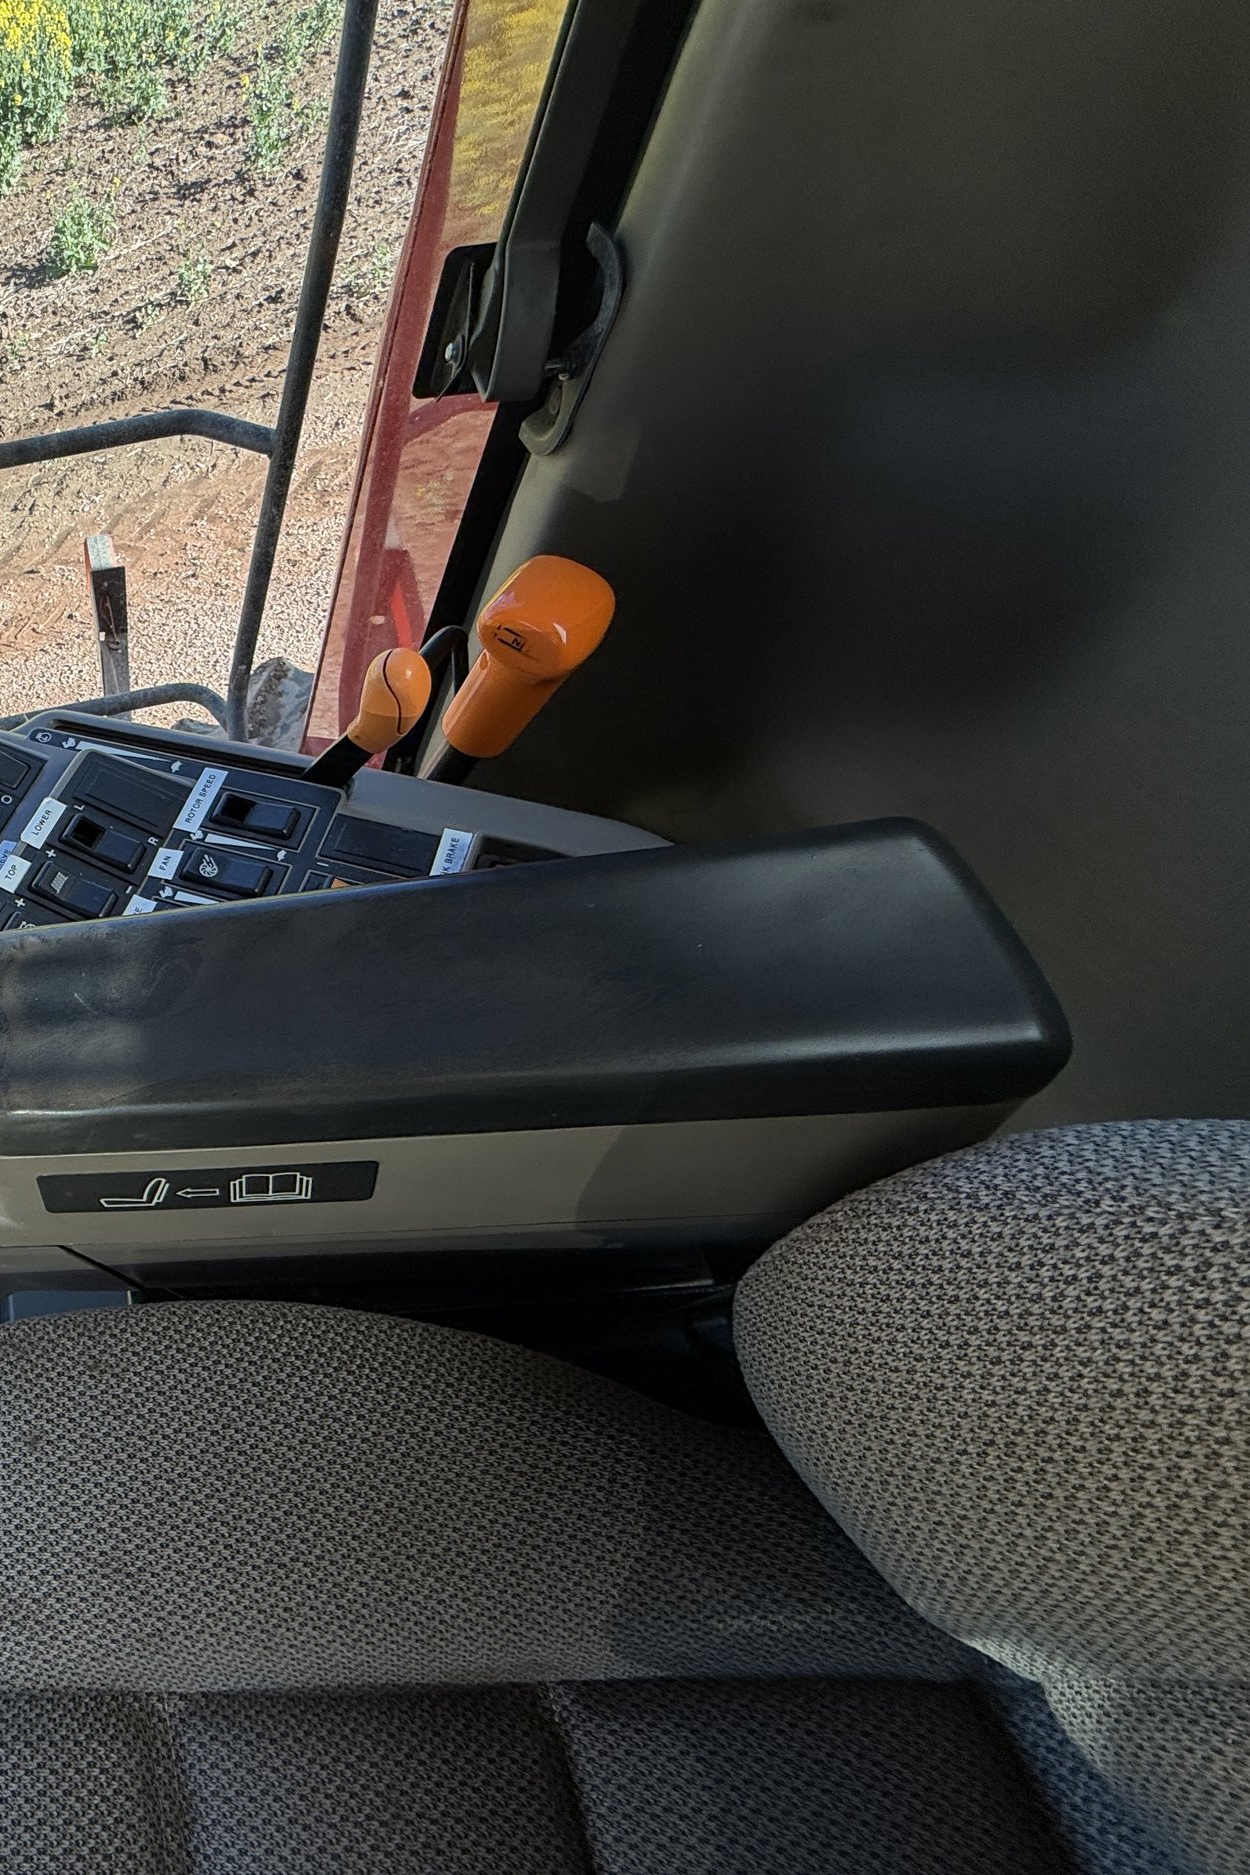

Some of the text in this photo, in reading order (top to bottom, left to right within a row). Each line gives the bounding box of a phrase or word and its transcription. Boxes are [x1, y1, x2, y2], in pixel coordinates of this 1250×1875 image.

[185, 774, 216, 823] ROTOR SPEED
[32, 809, 52, 836] LOWER
[159, 855, 171, 871] FAN
[444, 837, 460, 864] BRAKE
[4, 864, 18, 880] TOP
